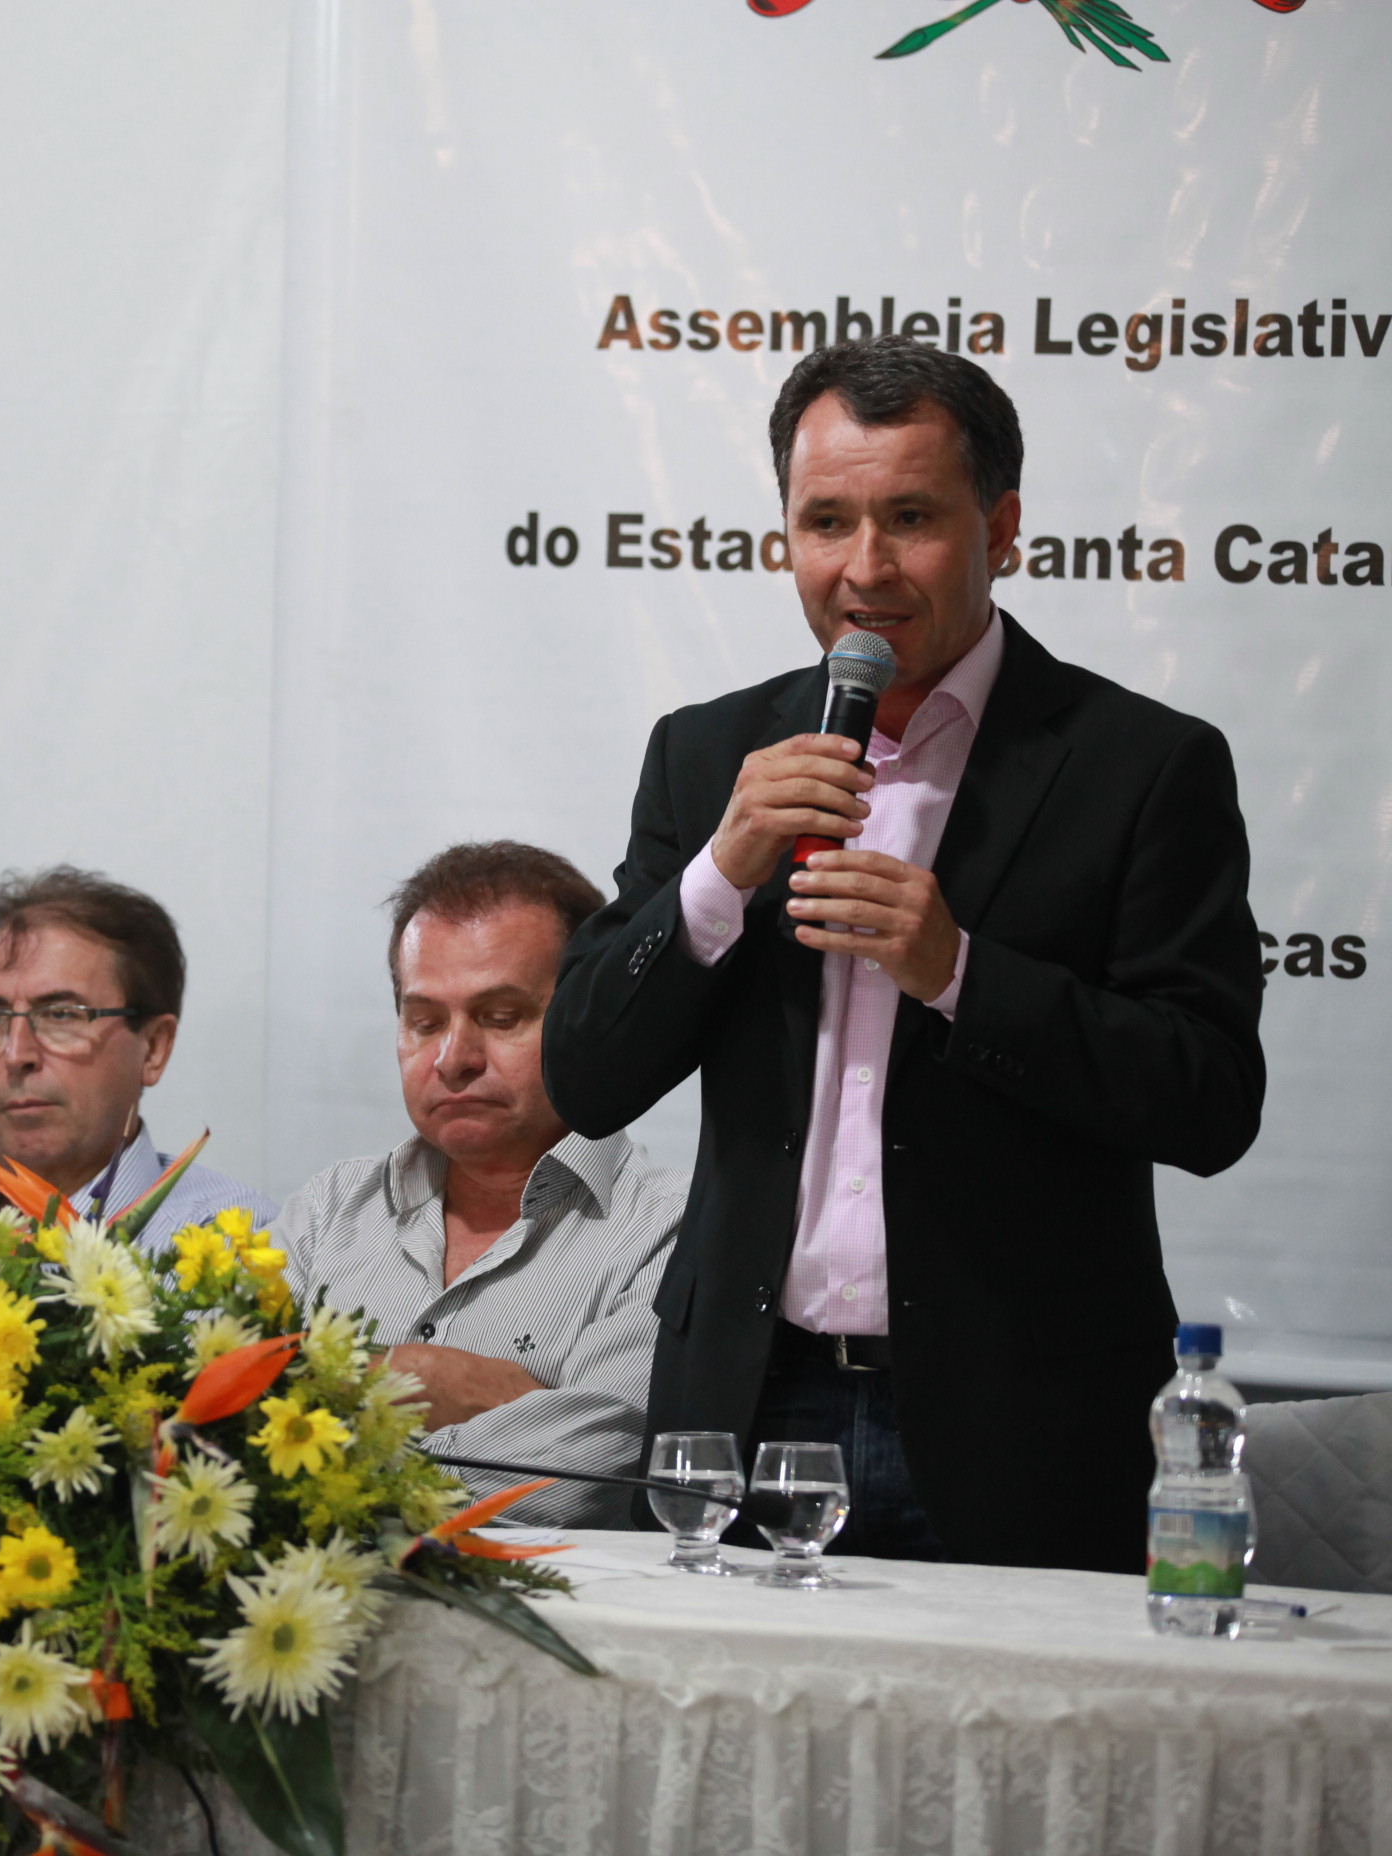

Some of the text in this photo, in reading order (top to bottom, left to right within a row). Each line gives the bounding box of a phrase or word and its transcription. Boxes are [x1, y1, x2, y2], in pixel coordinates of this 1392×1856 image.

[596, 294, 1392, 373] Assembleia Legislativ
[506, 511, 579, 568] do
[1214, 523, 1392, 587] Cata
